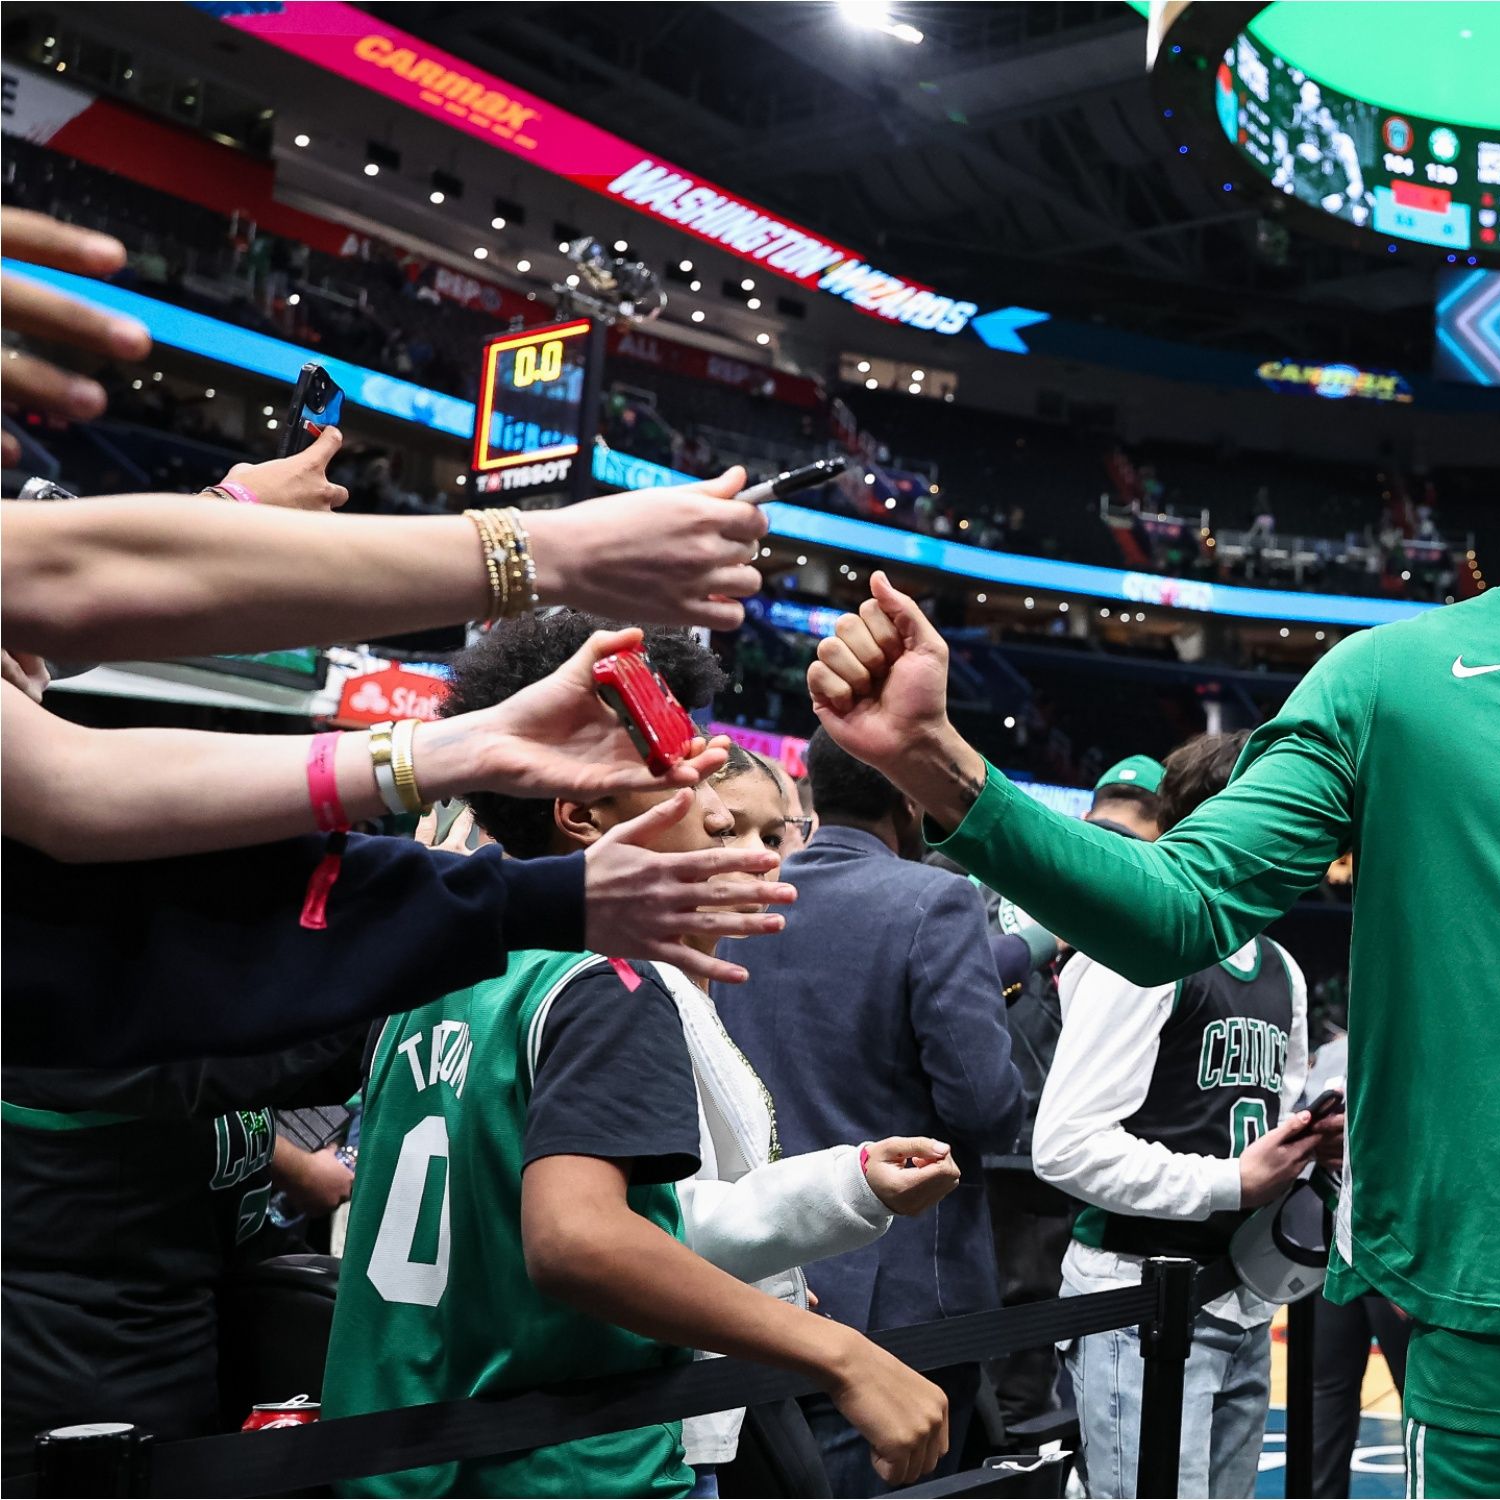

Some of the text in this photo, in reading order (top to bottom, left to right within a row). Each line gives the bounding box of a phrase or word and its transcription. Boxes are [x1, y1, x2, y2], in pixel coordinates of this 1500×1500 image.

[607, 159, 978, 335] WASHINGTON WIZARDS
[514, 340, 564, 387] 0.0
[366, 1116, 450, 1307] 0
